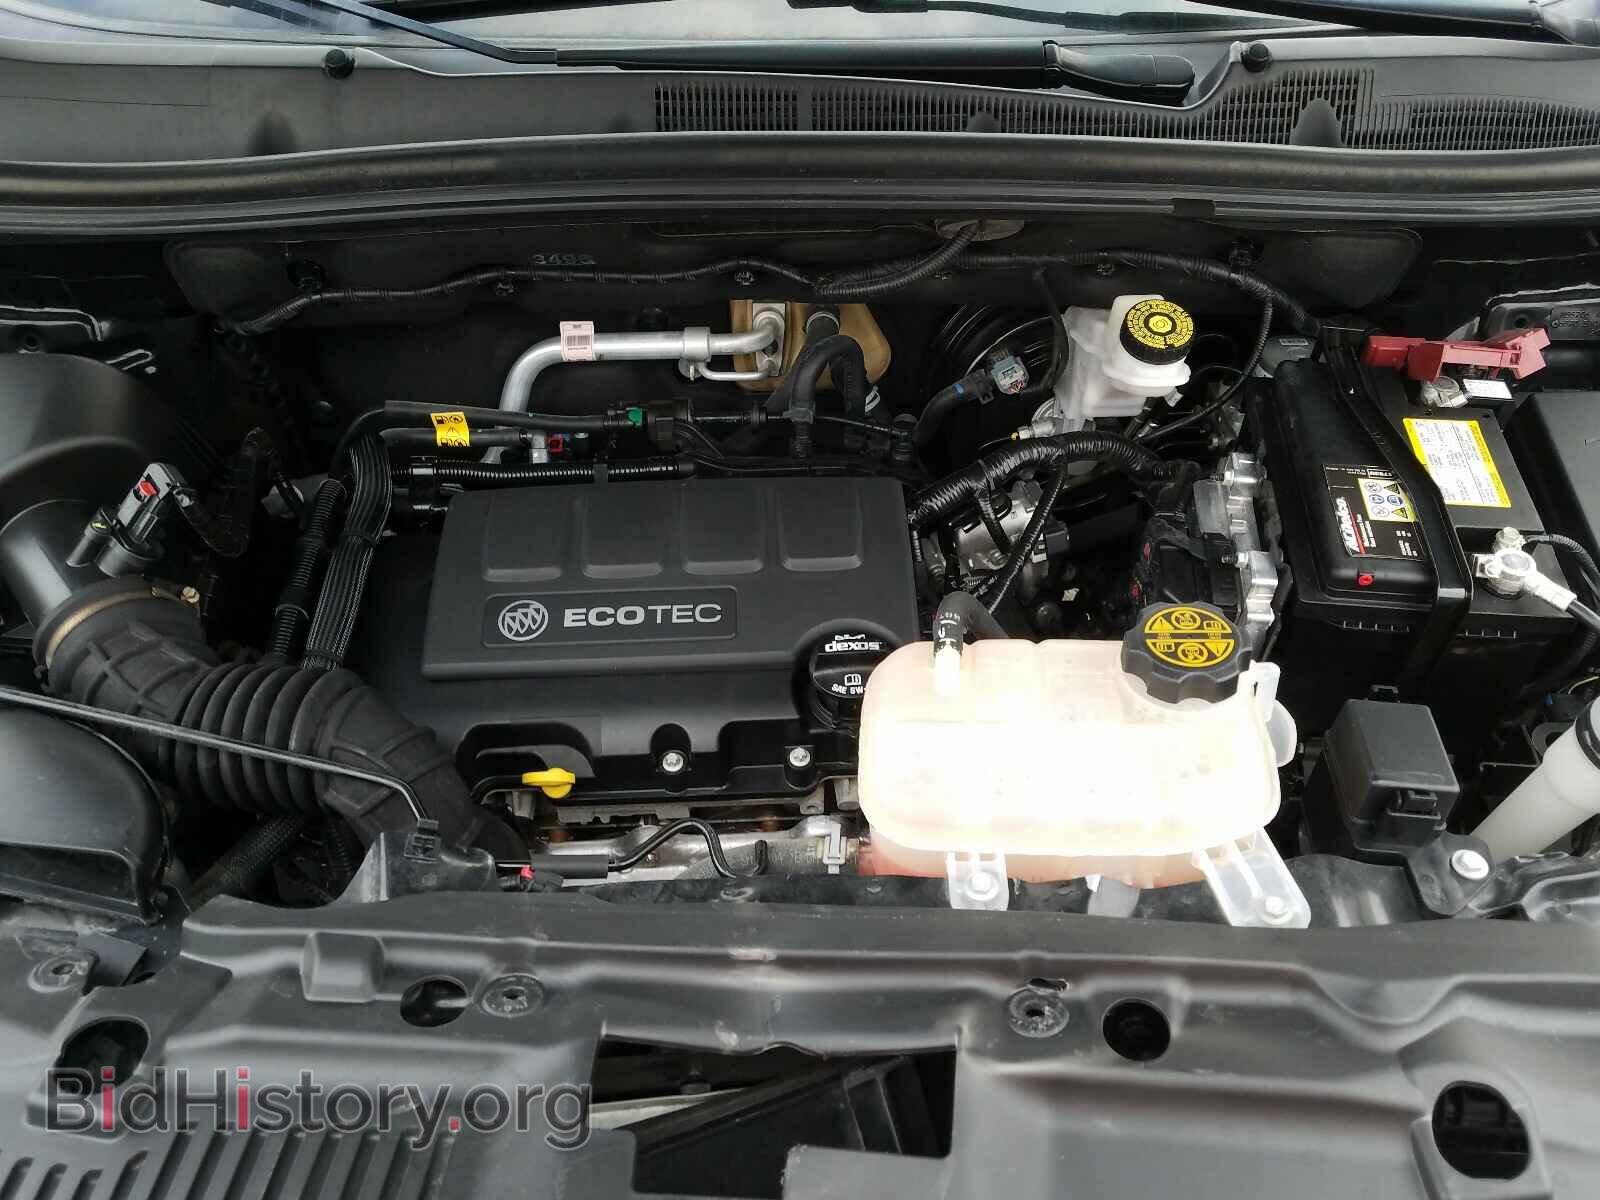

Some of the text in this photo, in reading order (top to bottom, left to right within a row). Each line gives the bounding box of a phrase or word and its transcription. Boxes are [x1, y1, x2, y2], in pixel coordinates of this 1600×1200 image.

[563, 603, 722, 627] ECOTEC
[824, 640, 880, 652] dexos
[831, 683, 847, 695] SAE
